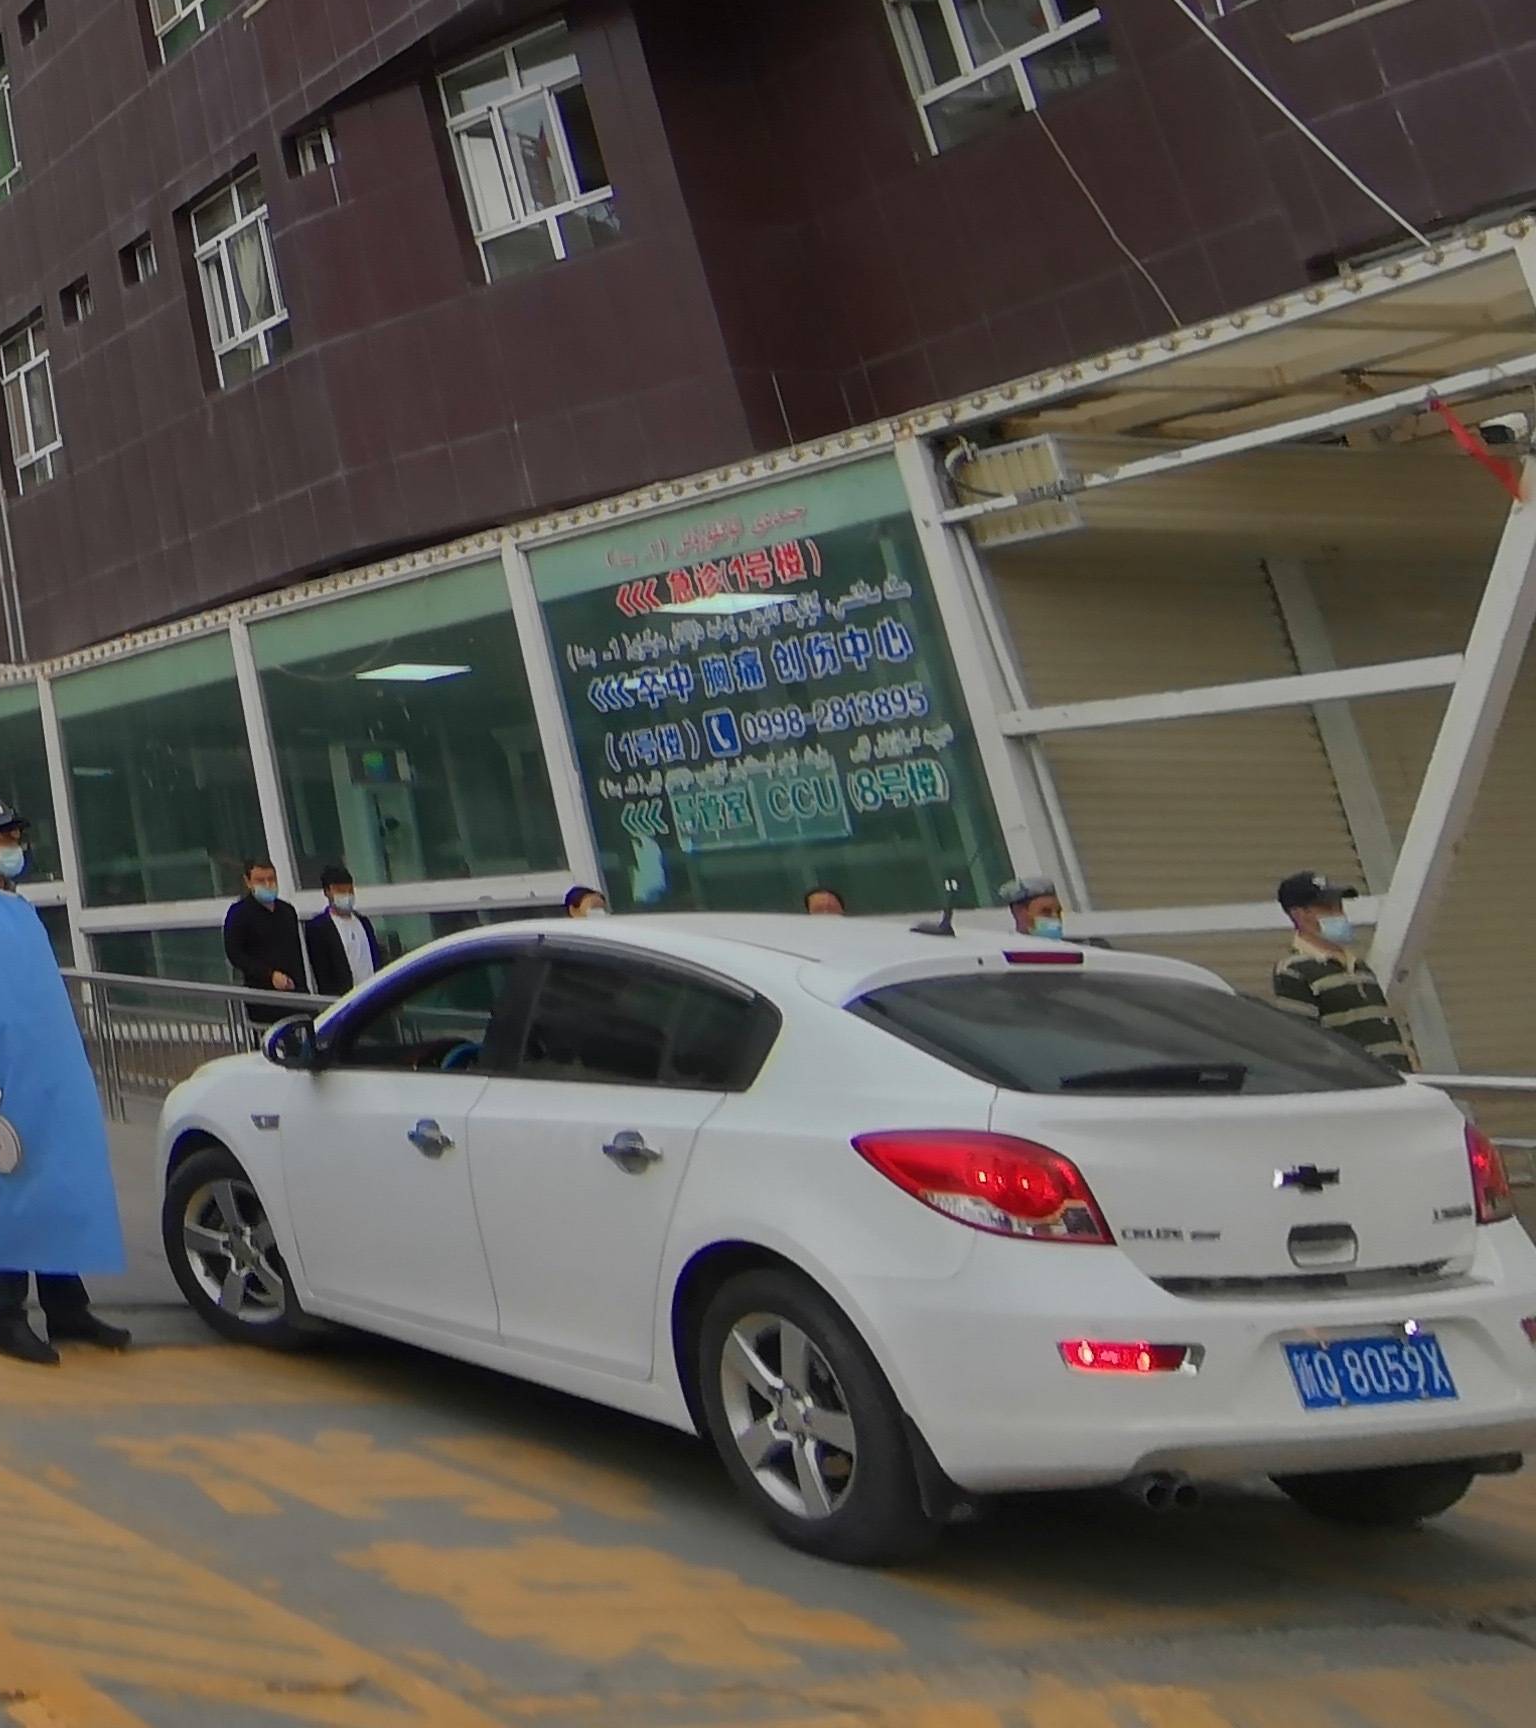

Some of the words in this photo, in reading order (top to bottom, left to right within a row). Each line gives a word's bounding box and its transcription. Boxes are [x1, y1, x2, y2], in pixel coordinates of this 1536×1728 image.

[636, 659, 694, 709] 卒中
[701, 647, 766, 698] 胸痛
[770, 616, 914, 686] 创伤中心
[742, 682, 928, 746] 0998-2813895
[767, 775, 844, 822] CCU
